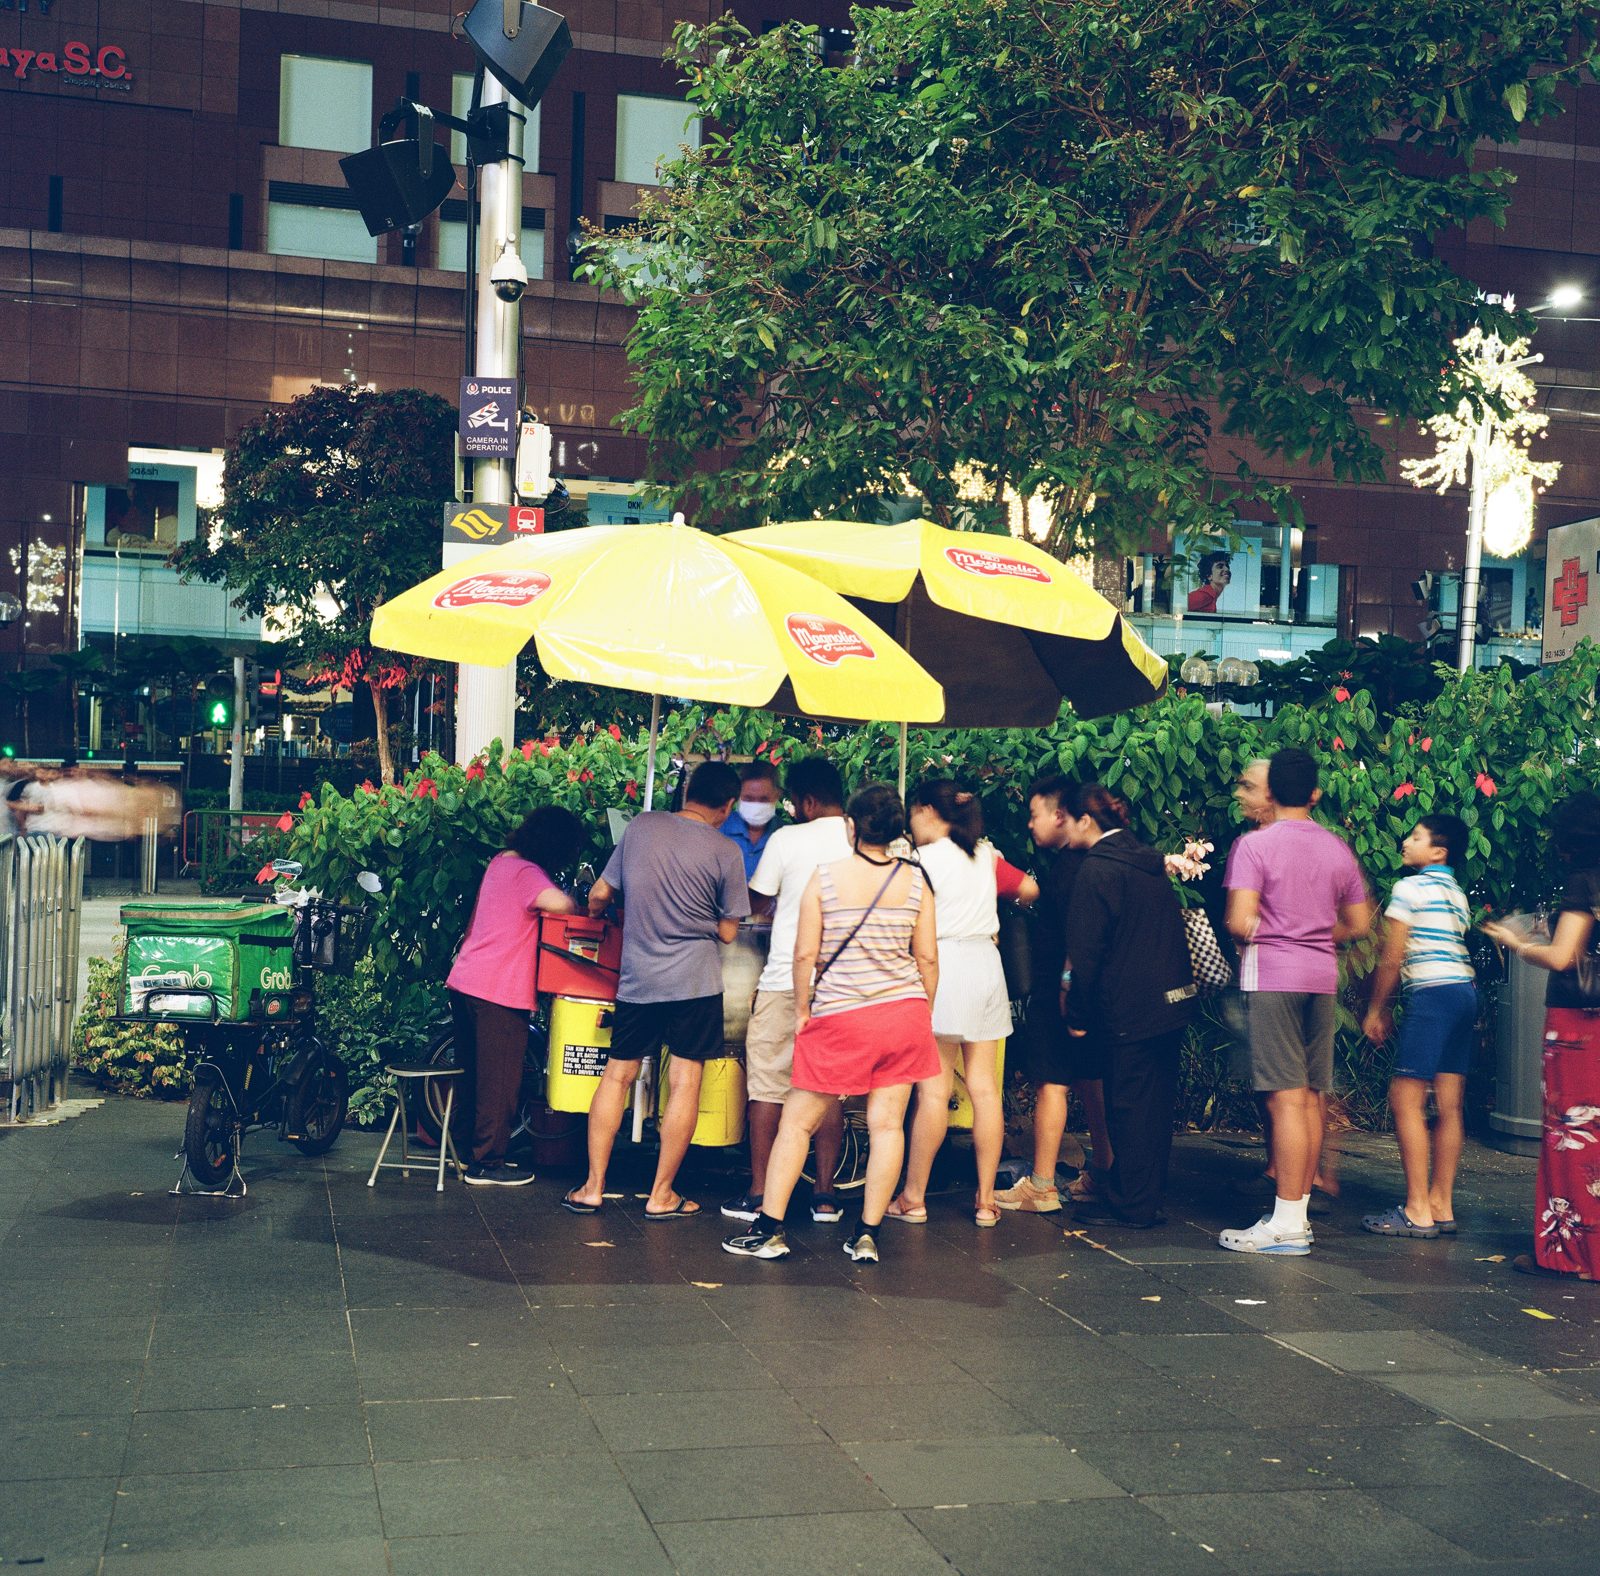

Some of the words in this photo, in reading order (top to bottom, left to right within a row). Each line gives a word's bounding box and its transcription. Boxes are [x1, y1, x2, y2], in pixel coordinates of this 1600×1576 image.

[481, 386, 512, 395] POLICE
[466, 436, 499, 444] CAMERA
[524, 427, 535, 435] 75
[952, 552, 1040, 574] Magnolia
[451, 579, 543, 599] Magnolia
[792, 628, 862, 651] Magnolia
[260, 967, 292, 990] Grab
